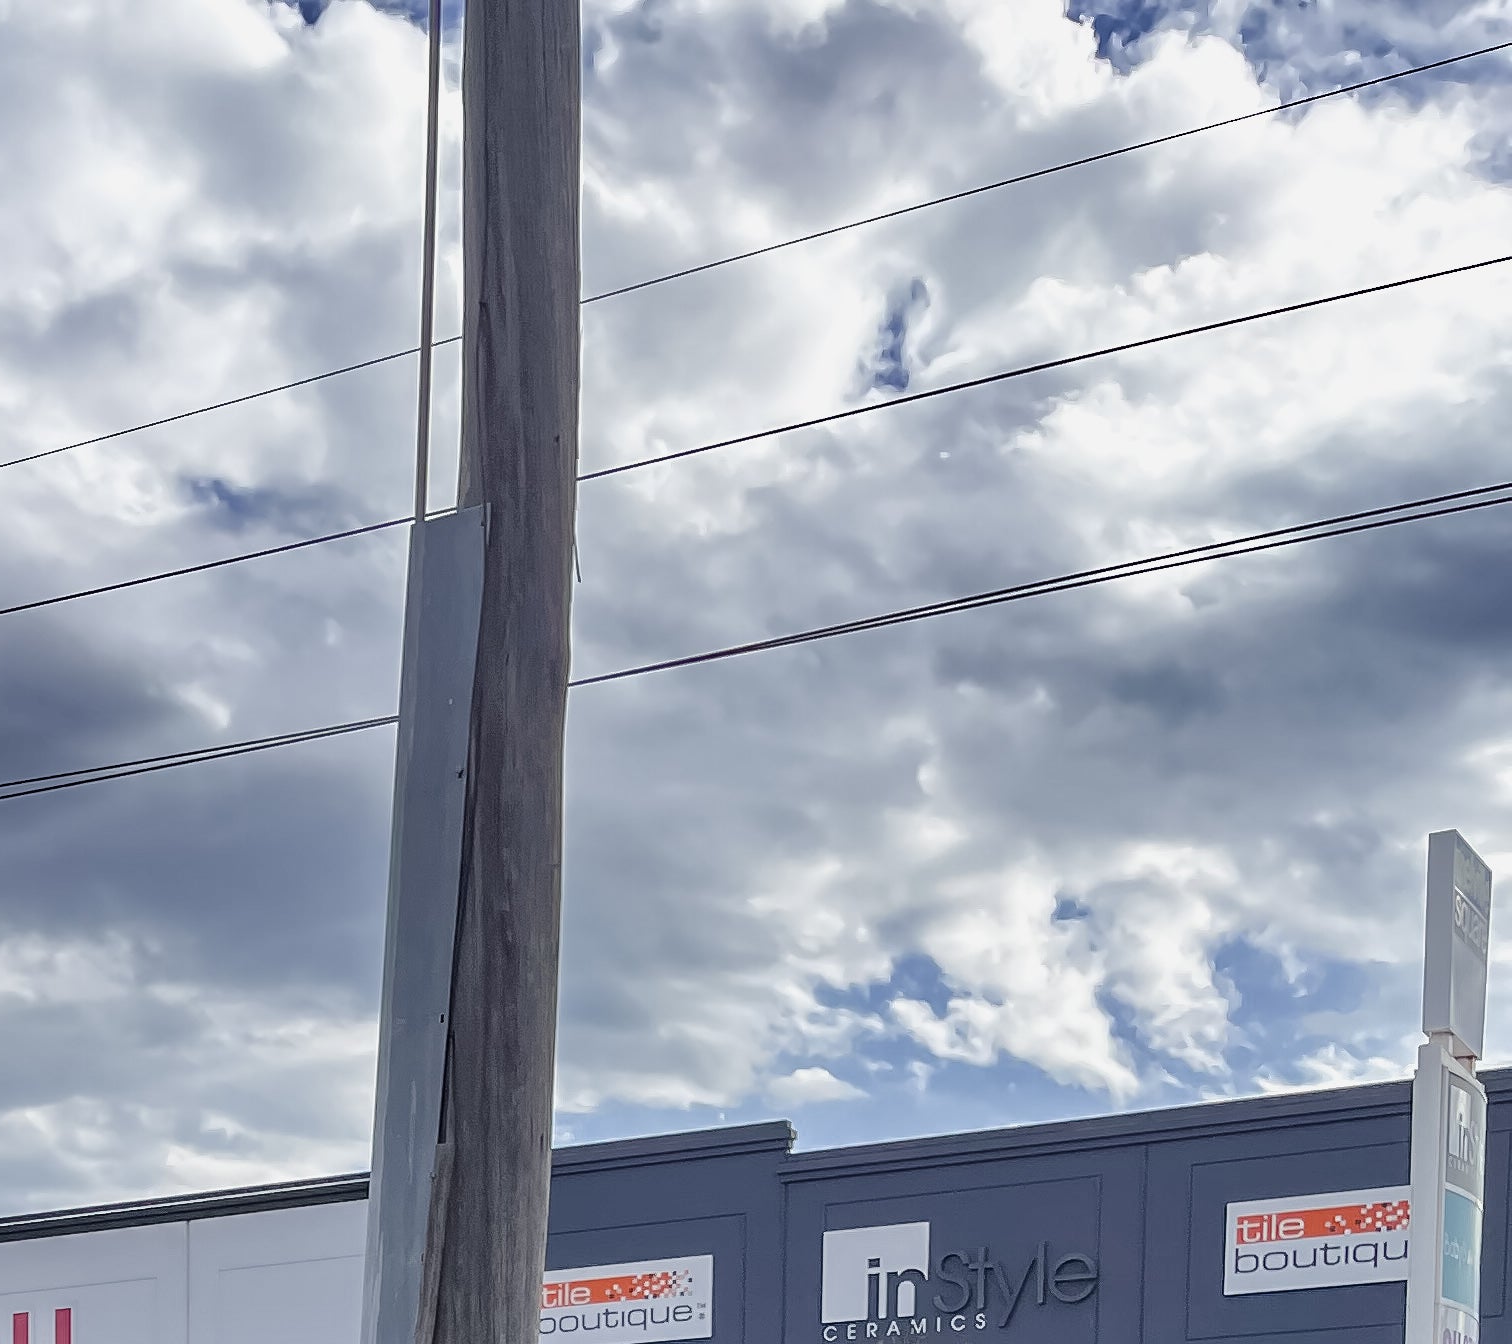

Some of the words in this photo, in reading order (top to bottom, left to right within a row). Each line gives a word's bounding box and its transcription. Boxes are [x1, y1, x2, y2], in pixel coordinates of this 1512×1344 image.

[1236, 1215, 1305, 1243] tile
[1234, 1240, 1409, 1275] boutiqu
[542, 1283, 591, 1308] tile
[823, 1313, 987, 1343] CERAMICS
